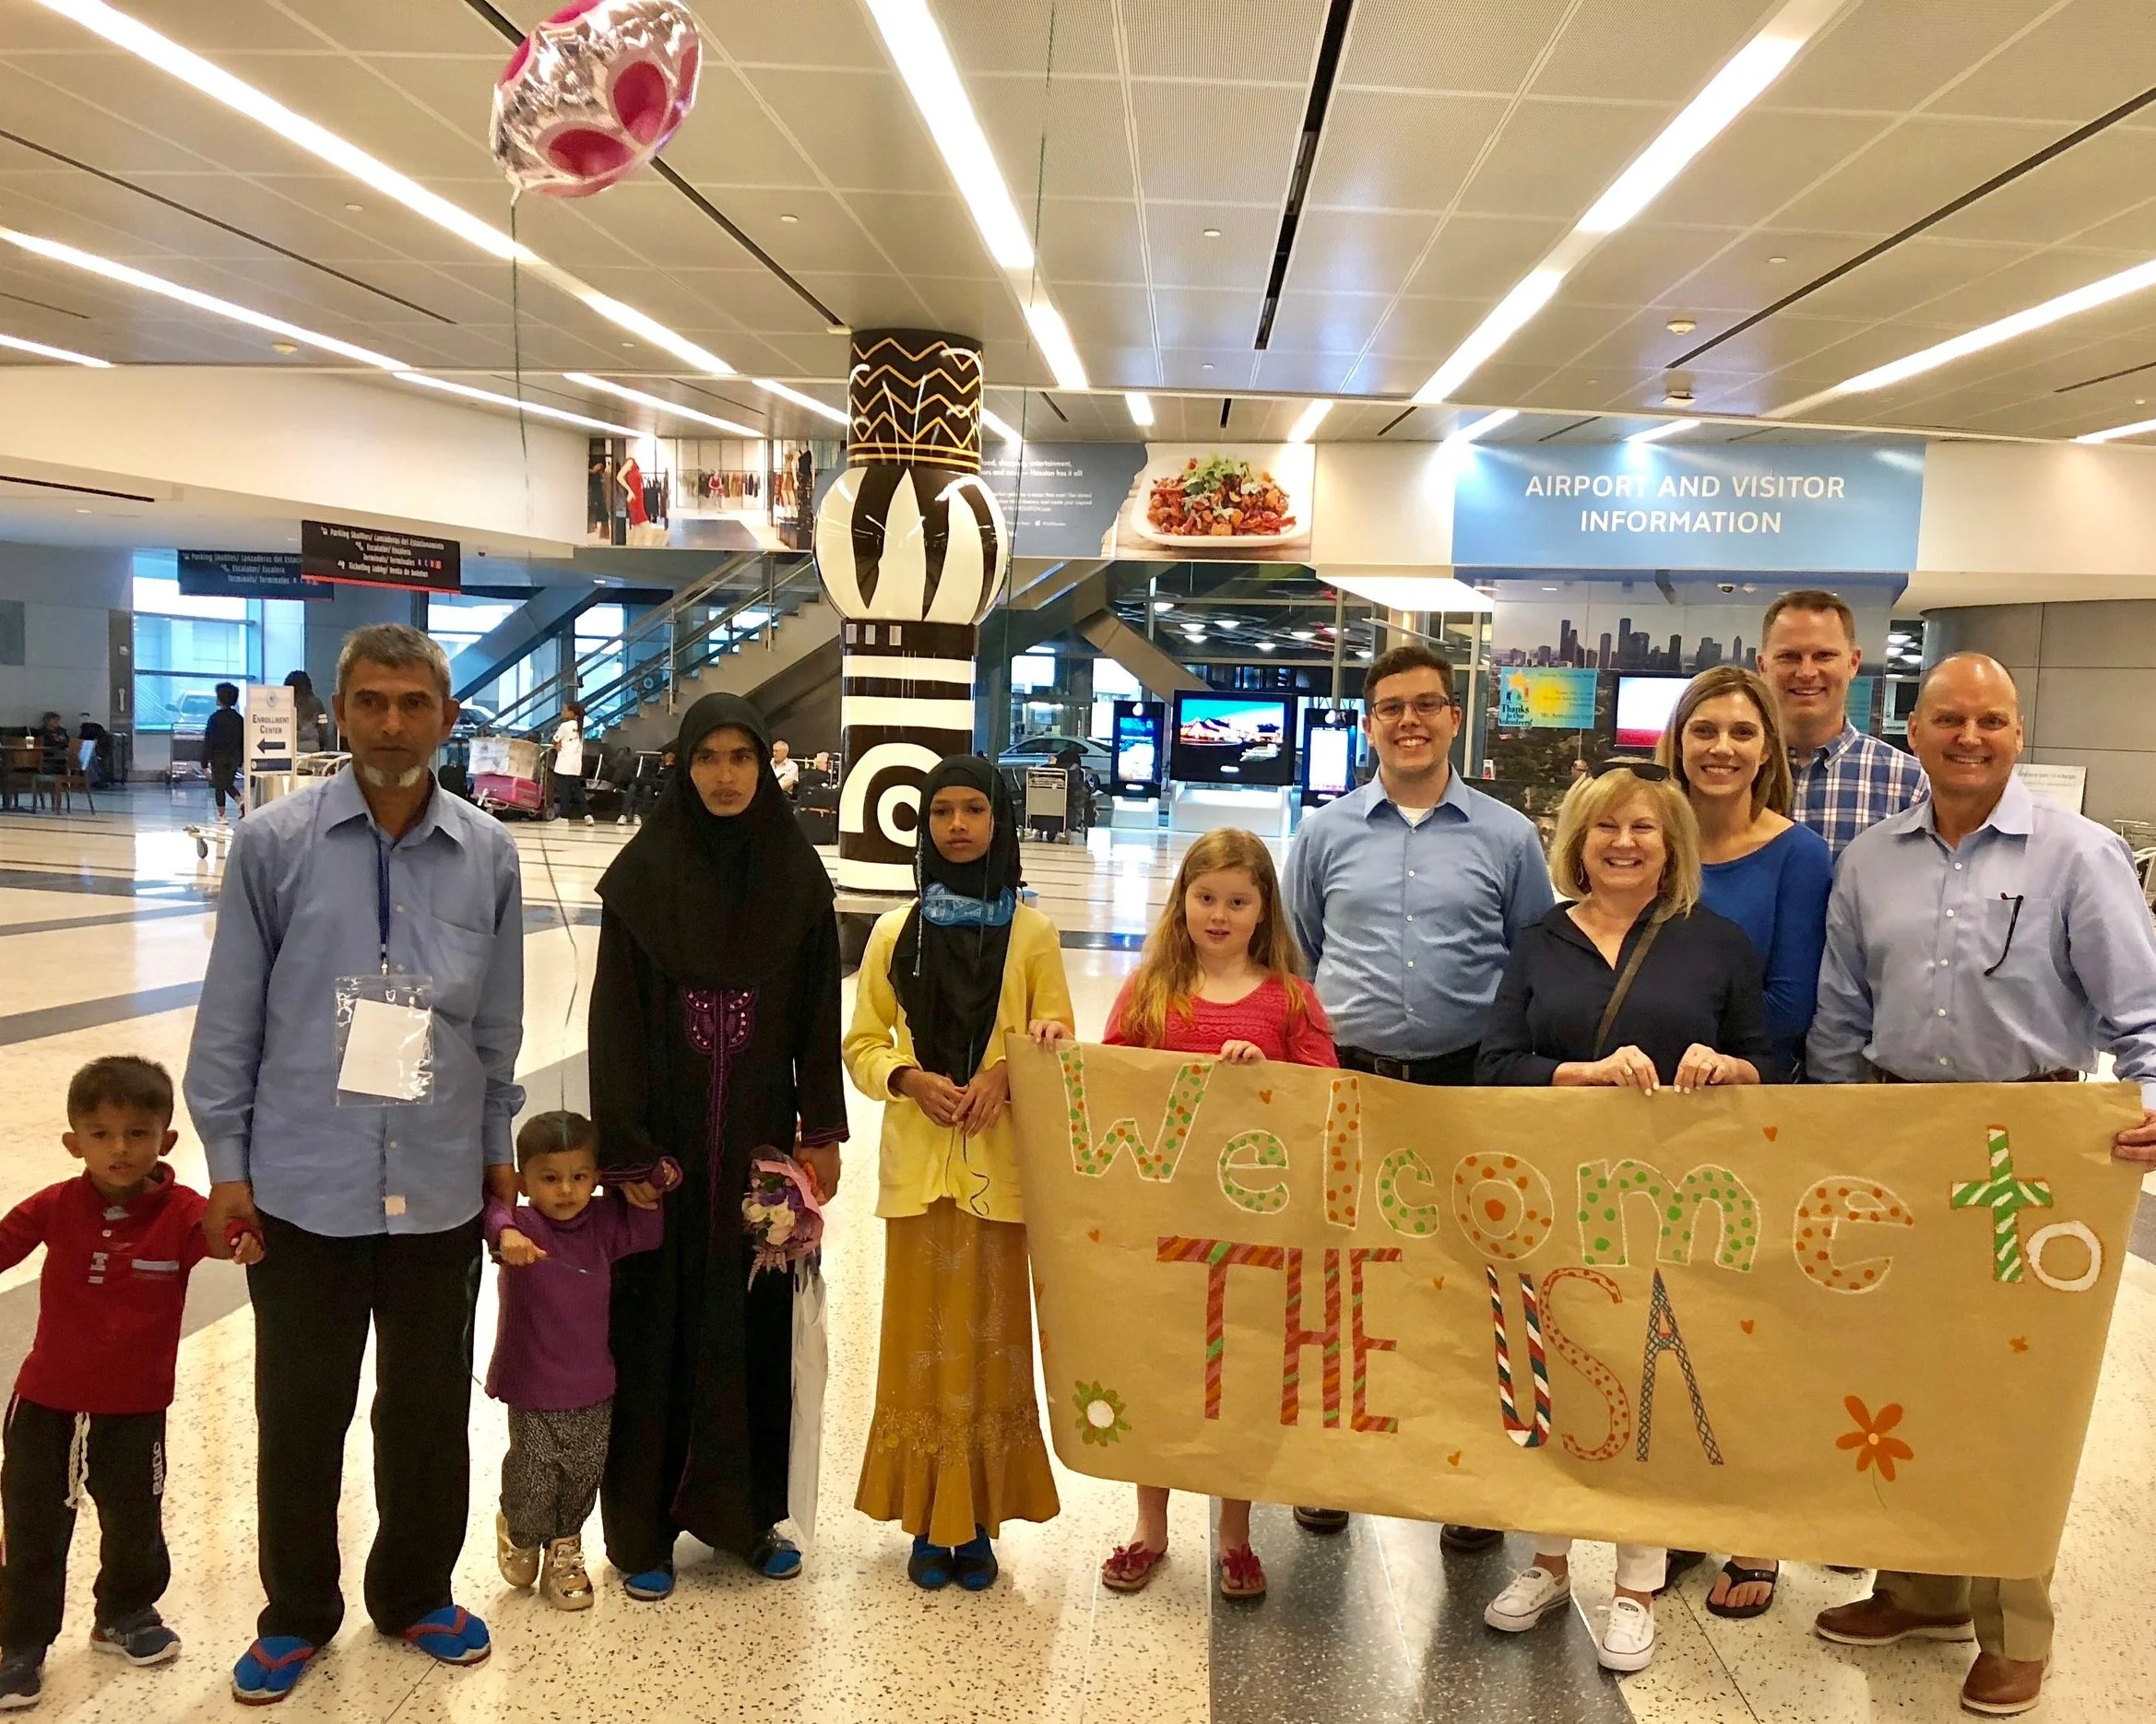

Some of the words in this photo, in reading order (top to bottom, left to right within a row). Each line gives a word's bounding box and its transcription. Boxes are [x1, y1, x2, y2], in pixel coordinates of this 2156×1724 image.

[1525, 474, 1646, 498] AIRPORT
[1657, 475, 1720, 498] AND
[1732, 475, 1845, 499] VISITOR
[330, 528, 349, 540] Parking
[1580, 510, 1782, 534] INFORMATION
[191, 553, 213, 562] Parking
[1501, 703, 1530, 714] Thanks
[1057, 1045, 1915, 1295] Welcome
[1949, 1124, 2103, 1293] to
[1156, 1236, 1403, 1433] THE
[1486, 1264, 1724, 1465] USA
